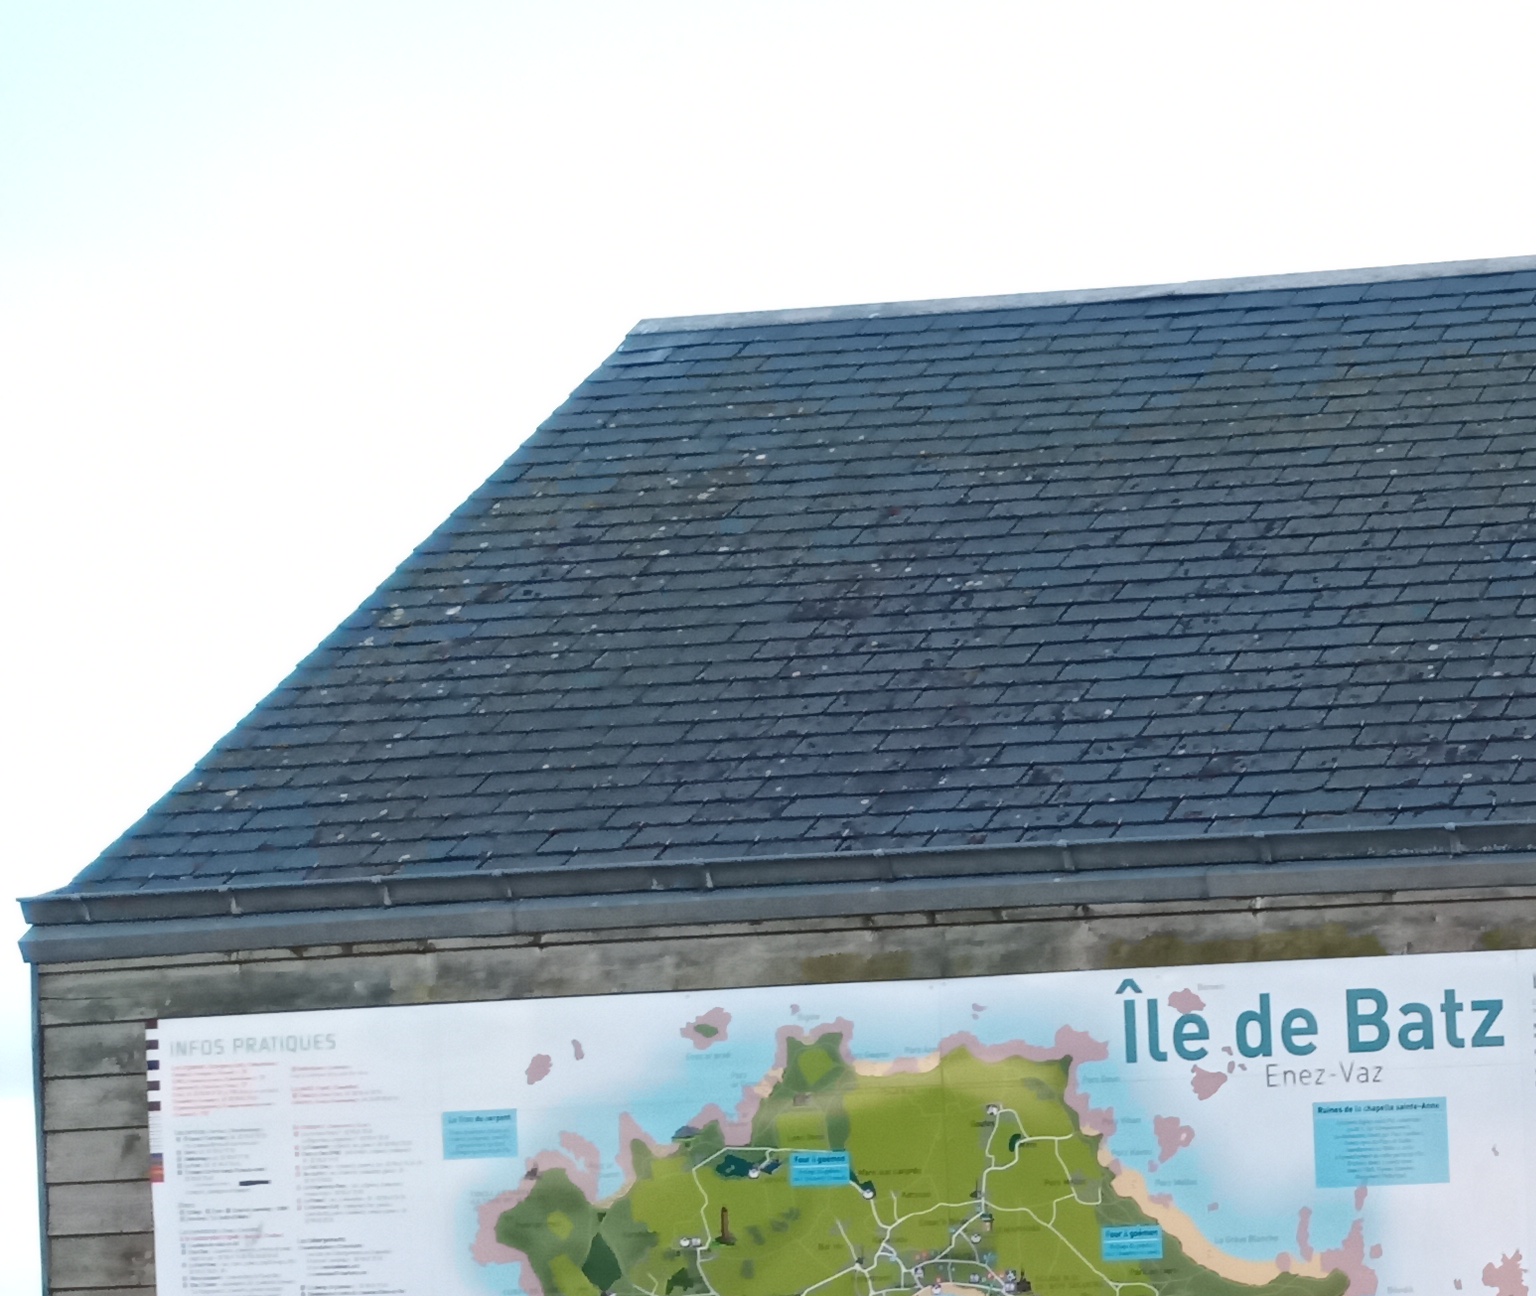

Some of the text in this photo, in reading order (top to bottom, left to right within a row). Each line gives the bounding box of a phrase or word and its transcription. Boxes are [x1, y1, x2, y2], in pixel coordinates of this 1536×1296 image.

[1115, 978, 1505, 1063] Île de Batz
[170, 1032, 337, 1057] INFOS PRATIQUES
[1266, 1061, 1384, 1088] Enez-Vaz
